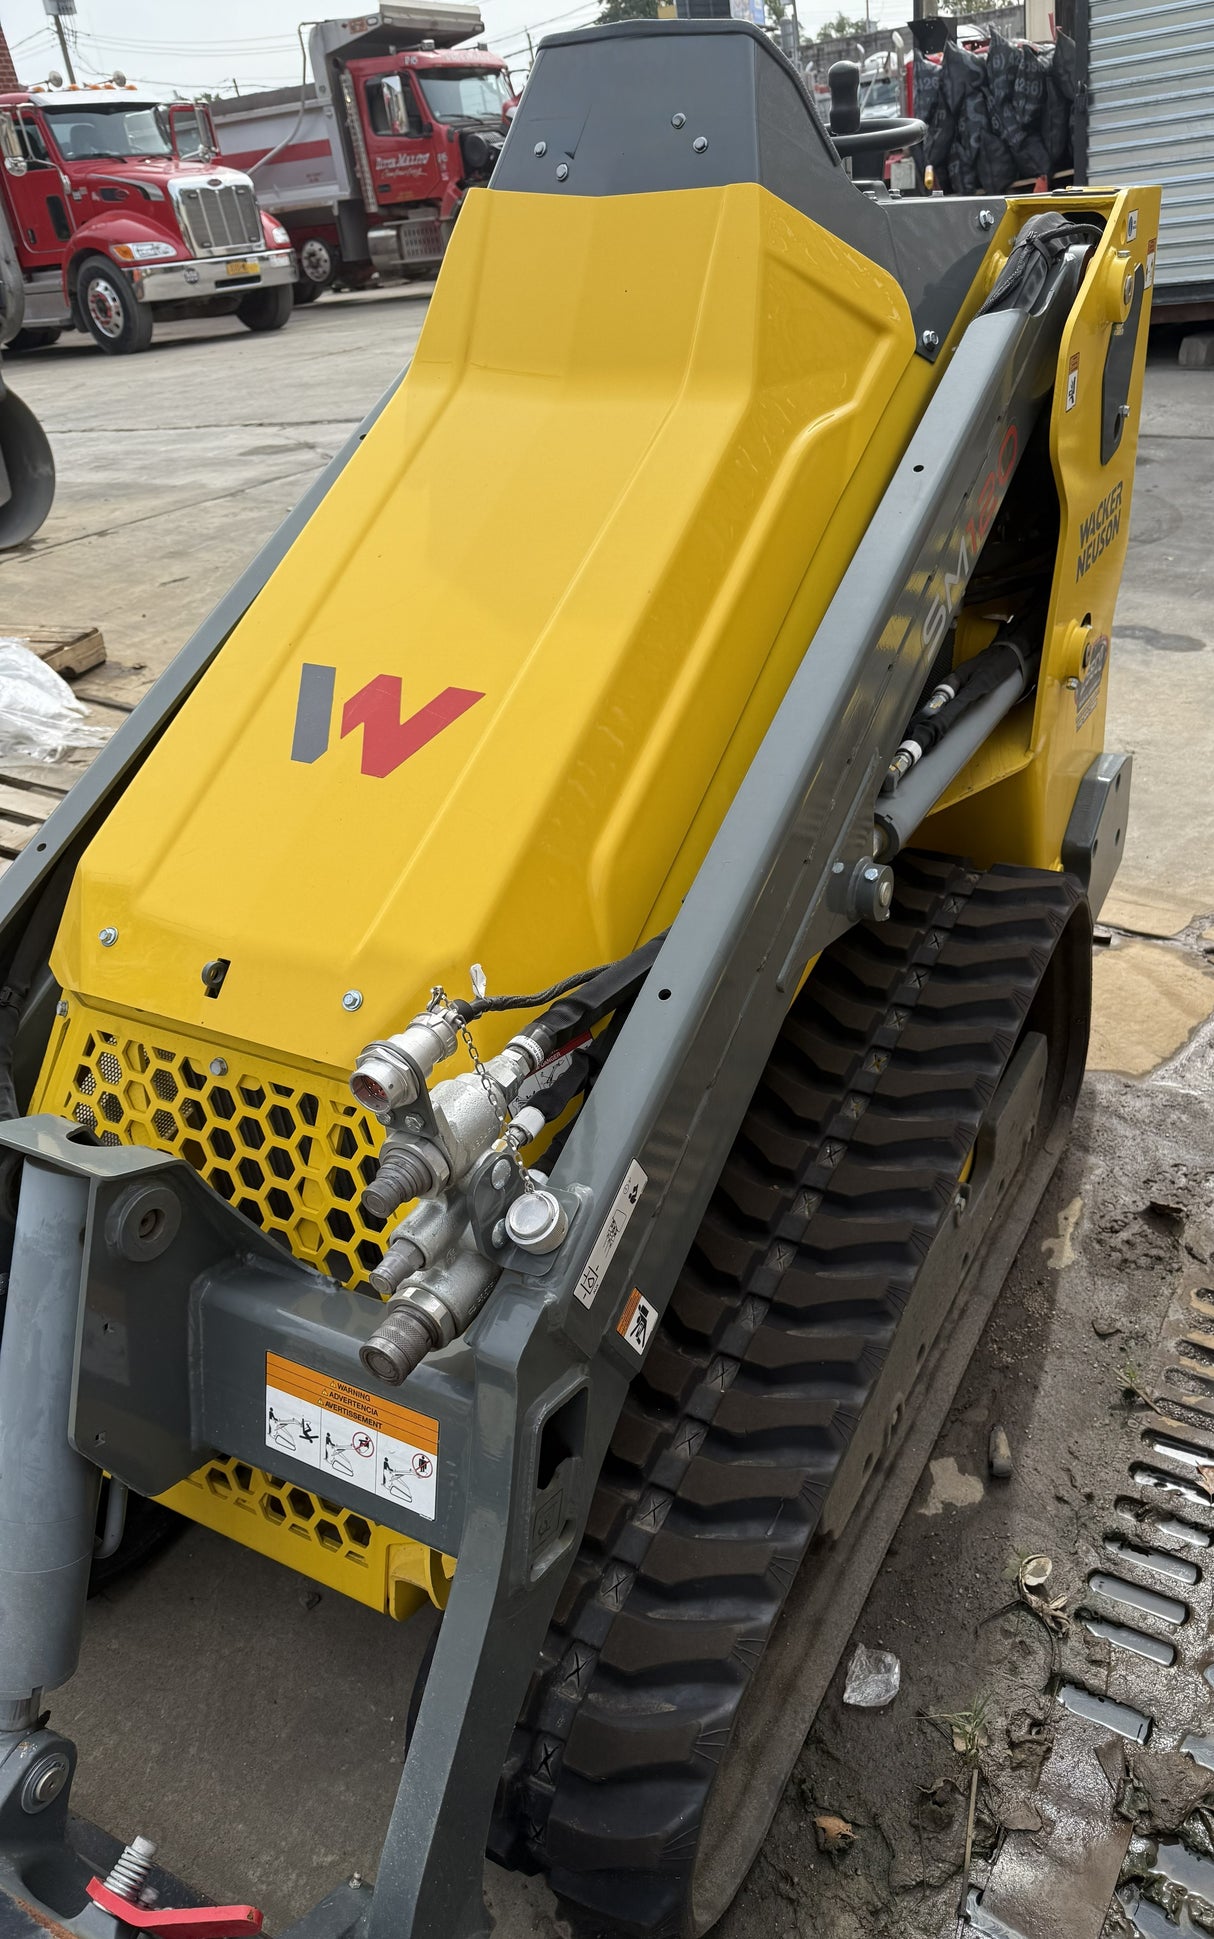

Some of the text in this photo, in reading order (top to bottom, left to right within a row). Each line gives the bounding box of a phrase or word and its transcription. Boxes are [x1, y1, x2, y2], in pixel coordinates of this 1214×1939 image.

[1080, 480, 1122, 549] WACKER
[1075, 508, 1122, 584] NEUSON
[329, 1391, 379, 1417] ADVERTENCIA
[337, 1383, 370, 1402] WARNING
[324, 1400, 383, 1429] AVERTISSEMENT
